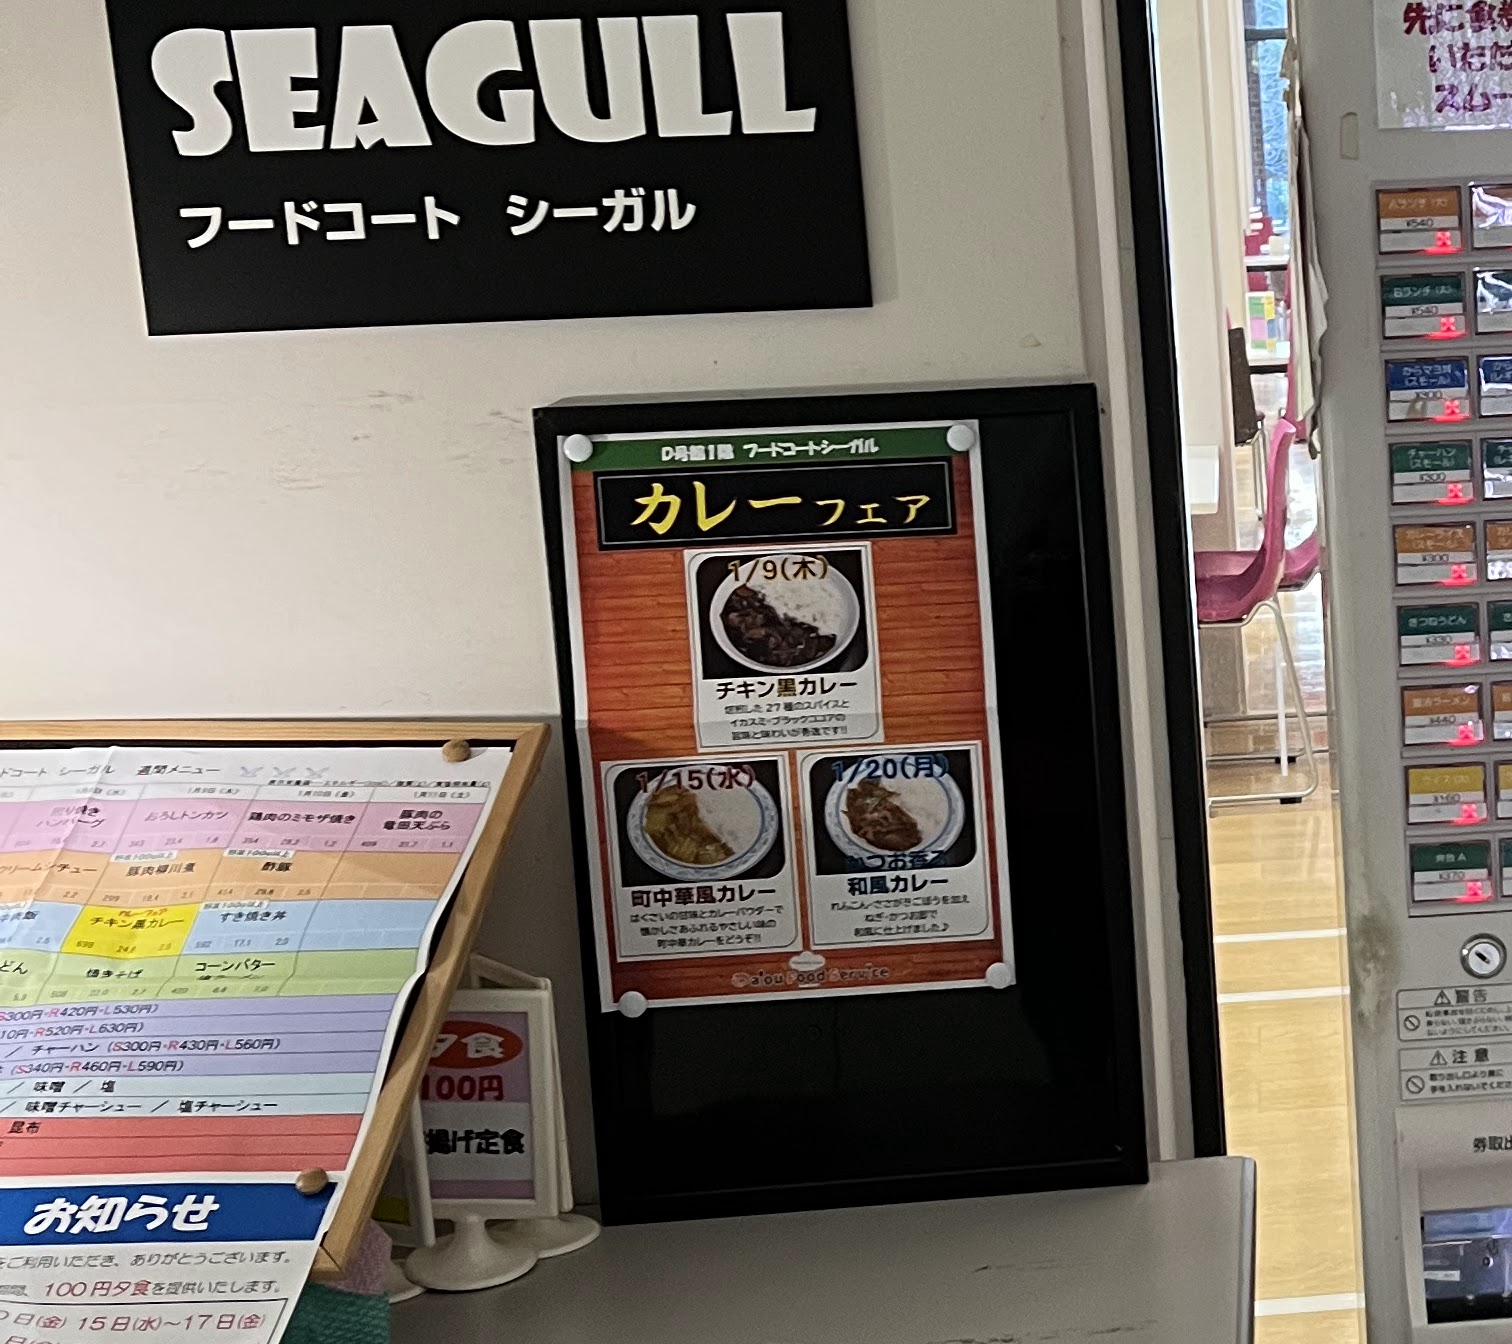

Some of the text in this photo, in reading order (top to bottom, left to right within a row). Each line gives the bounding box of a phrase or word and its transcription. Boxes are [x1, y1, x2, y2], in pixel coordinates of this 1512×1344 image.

[150, 10, 817, 157] SEAGULL
[179, 187, 698, 249] フードコート シーガル
[743, 438, 879, 458] フードコートシーガル
[630, 480, 931, 535] カレーフェア
[728, 554, 829, 582] 1/9(木)
[716, 677, 858, 700] チキン黒カレー
[136, 765, 221, 776] 週間メニュー
[636, 764, 756, 793] 1/15(水)
[831, 754, 950, 783] 1/20(月)
[631, 885, 776, 907] 町中華風カレー
[847, 874, 949, 896] 和風カレー
[32, 1042, 101, 1055] チャーハン
[421, 1074, 505, 1102] 100円
[23, 1194, 220, 1235] お知らせ
